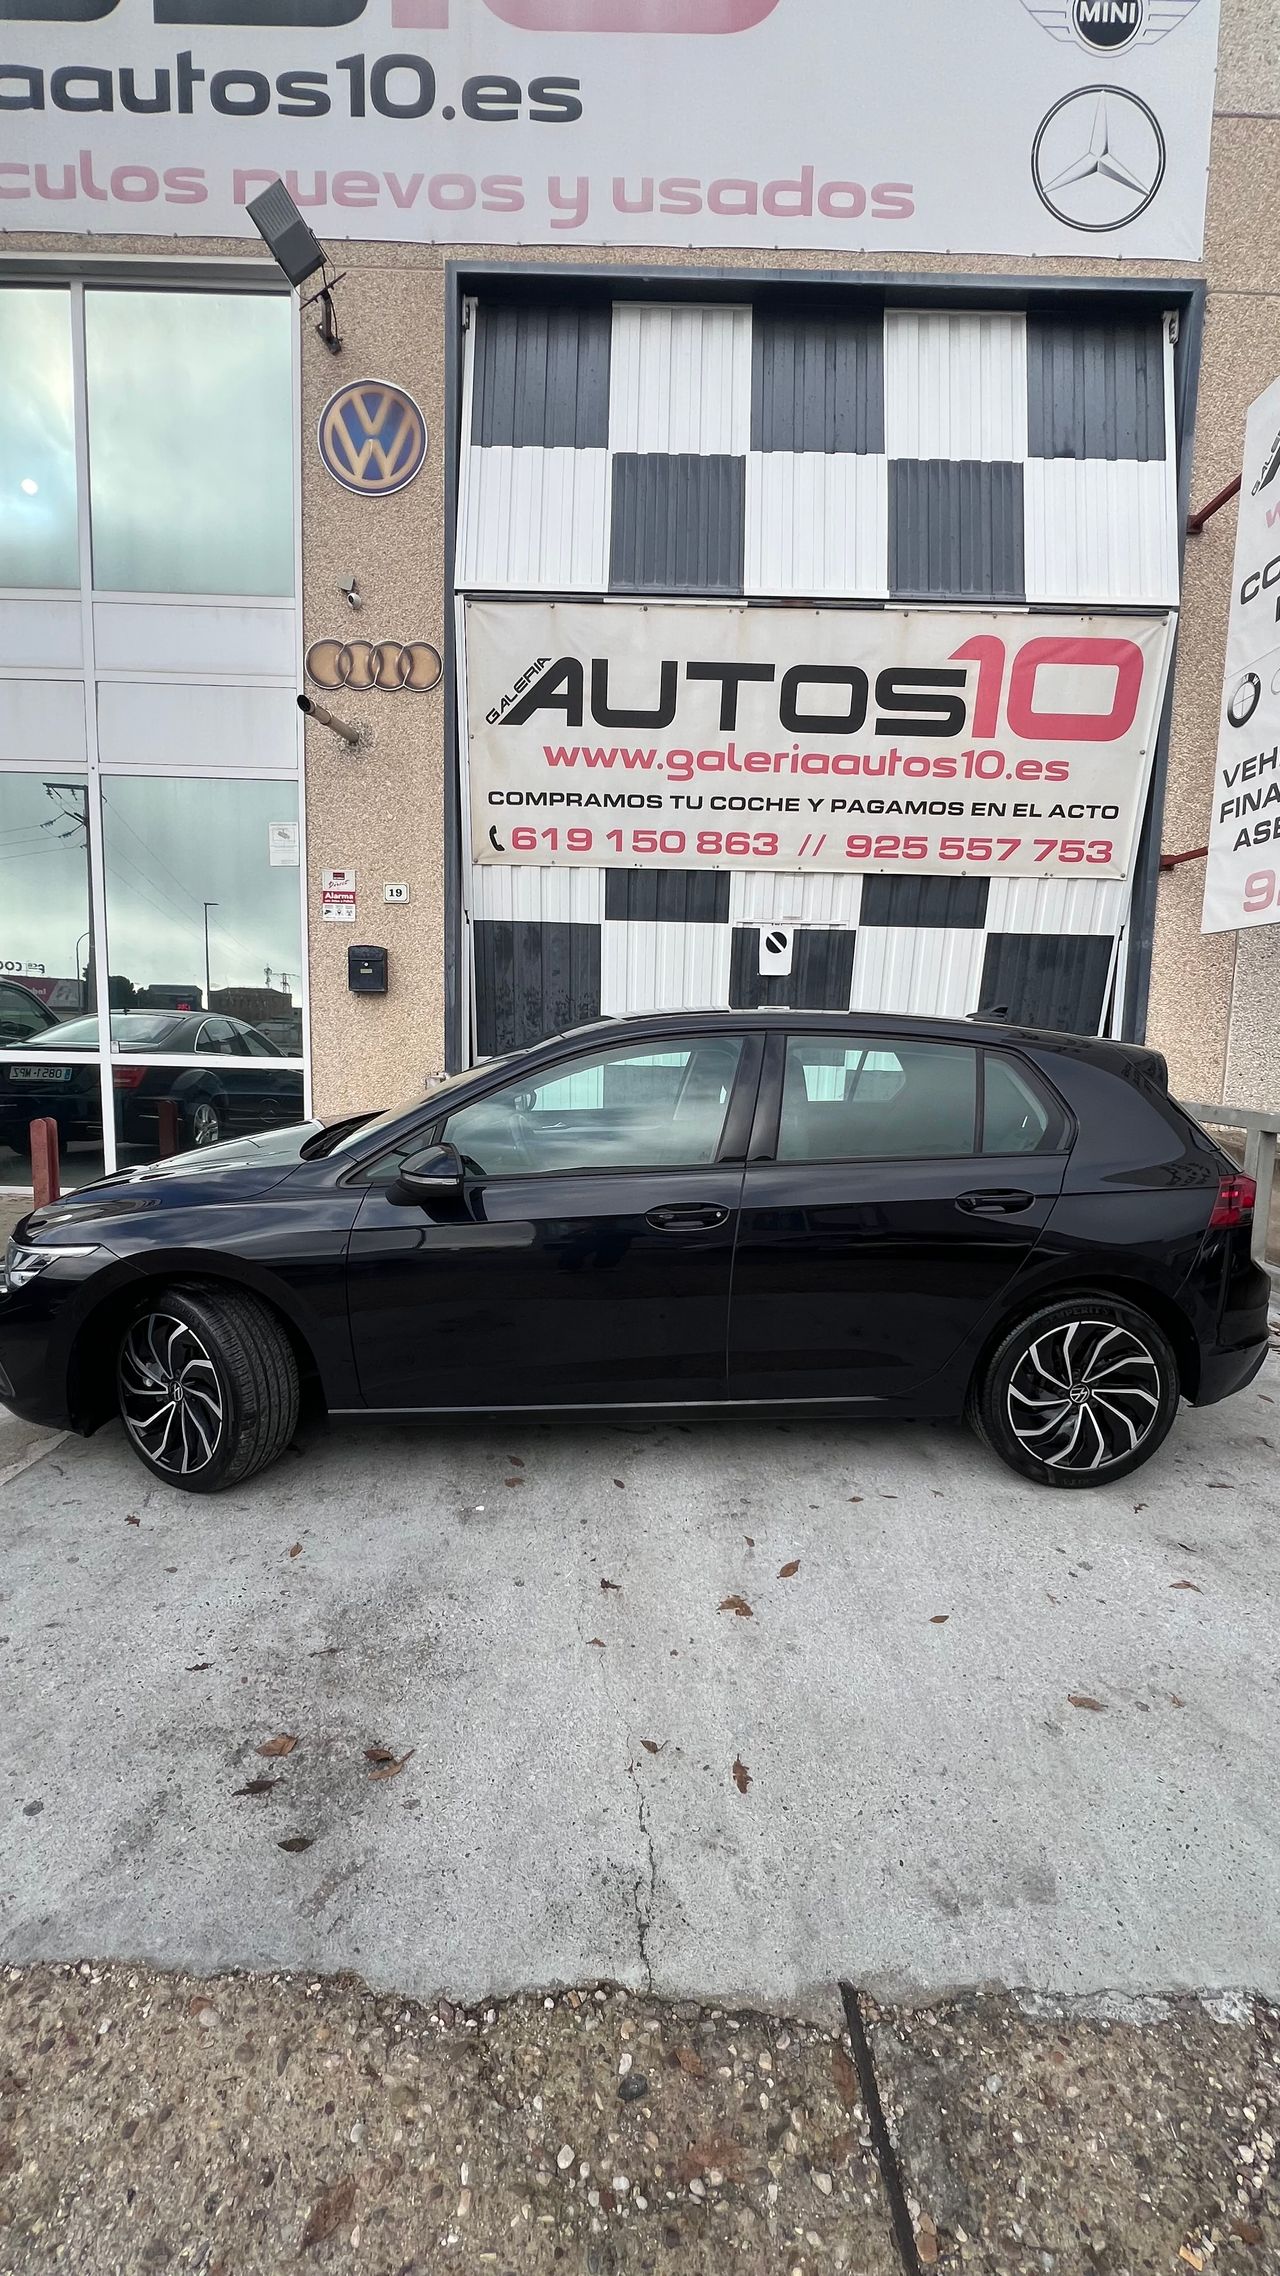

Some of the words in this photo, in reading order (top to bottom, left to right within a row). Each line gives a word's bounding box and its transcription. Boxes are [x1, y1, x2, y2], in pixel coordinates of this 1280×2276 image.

[1079, 1, 1137, 24] MINI
[233, 168, 525, 213] nuevos
[548, 176, 589, 230] y
[612, 166, 915, 220] usados
[485, 657, 552, 725] GALERIA
[543, 742, 1070, 783] www.galeriaautos10.es
[1223, 746, 1280, 788] VEH
[488, 791, 663, 809] COMPRAMOS
[670, 795, 703, 810] TU
[710, 796, 801, 812] COCHE
[807, 798, 825, 813] Y
[830, 798, 965, 816] PAGAMOS
[970, 802, 1007, 817] EN
[1012, 803, 1042, 818] EL
[1048, 804, 1120, 820] ACTO
[511, 826, 593, 853] 619
[607, 828, 687, 855] 150
[696, 831, 780, 858] 863
[845, 834, 929, 861] 925
[938, 836, 1023, 863] 557
[1033, 838, 1114, 865] 753
[324, 892, 354, 900] Alarma
[388, 888, 403, 898] 19
[1242, 868, 1280, 913] 9
